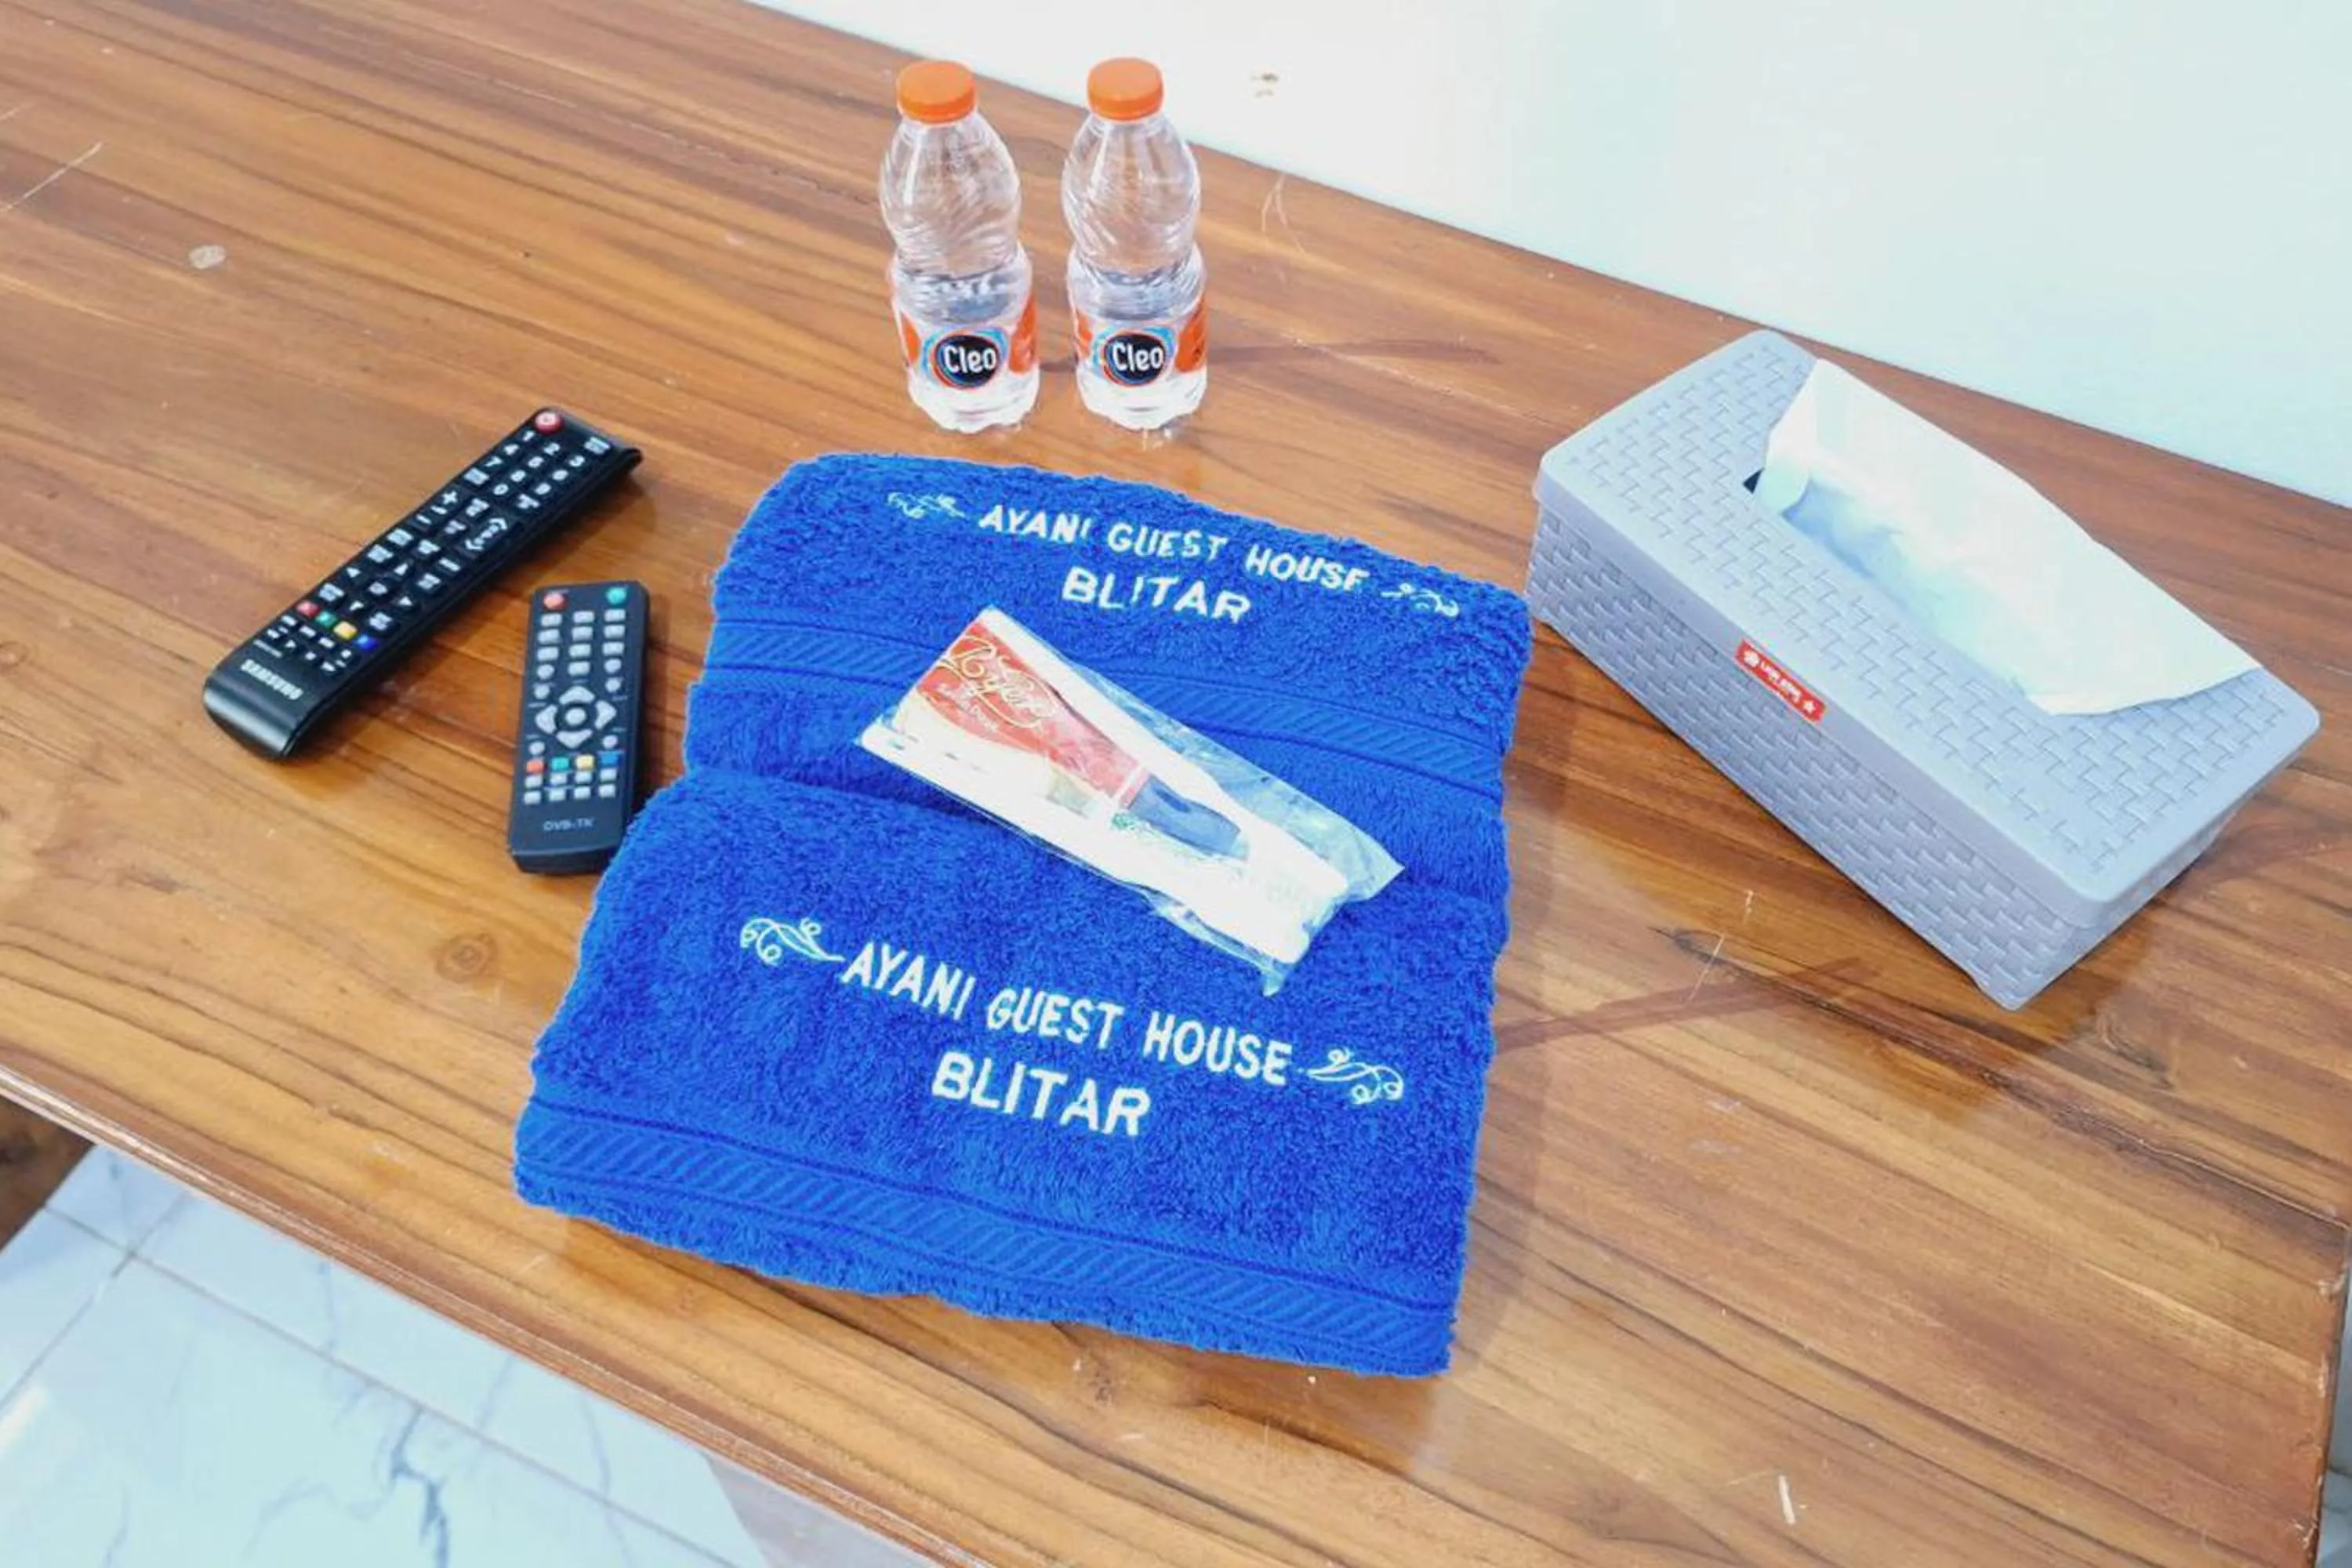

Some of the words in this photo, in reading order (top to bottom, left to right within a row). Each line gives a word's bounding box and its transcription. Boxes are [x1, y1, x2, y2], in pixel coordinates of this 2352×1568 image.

[943, 346, 998, 375] Cleo
[1111, 344, 1166, 373] Cleo
[568, 455, 585, 467] 3
[978, 503, 1093, 543] AYANI
[1106, 521, 1229, 562] GUEST
[1061, 565, 1252, 625] BLITAR
[840, 940, 977, 1022] AYANI
[985, 986, 1125, 1051] GUEST
[1143, 1010, 1294, 1087] HOUSE
[931, 1050, 1152, 1137] BLITAR
